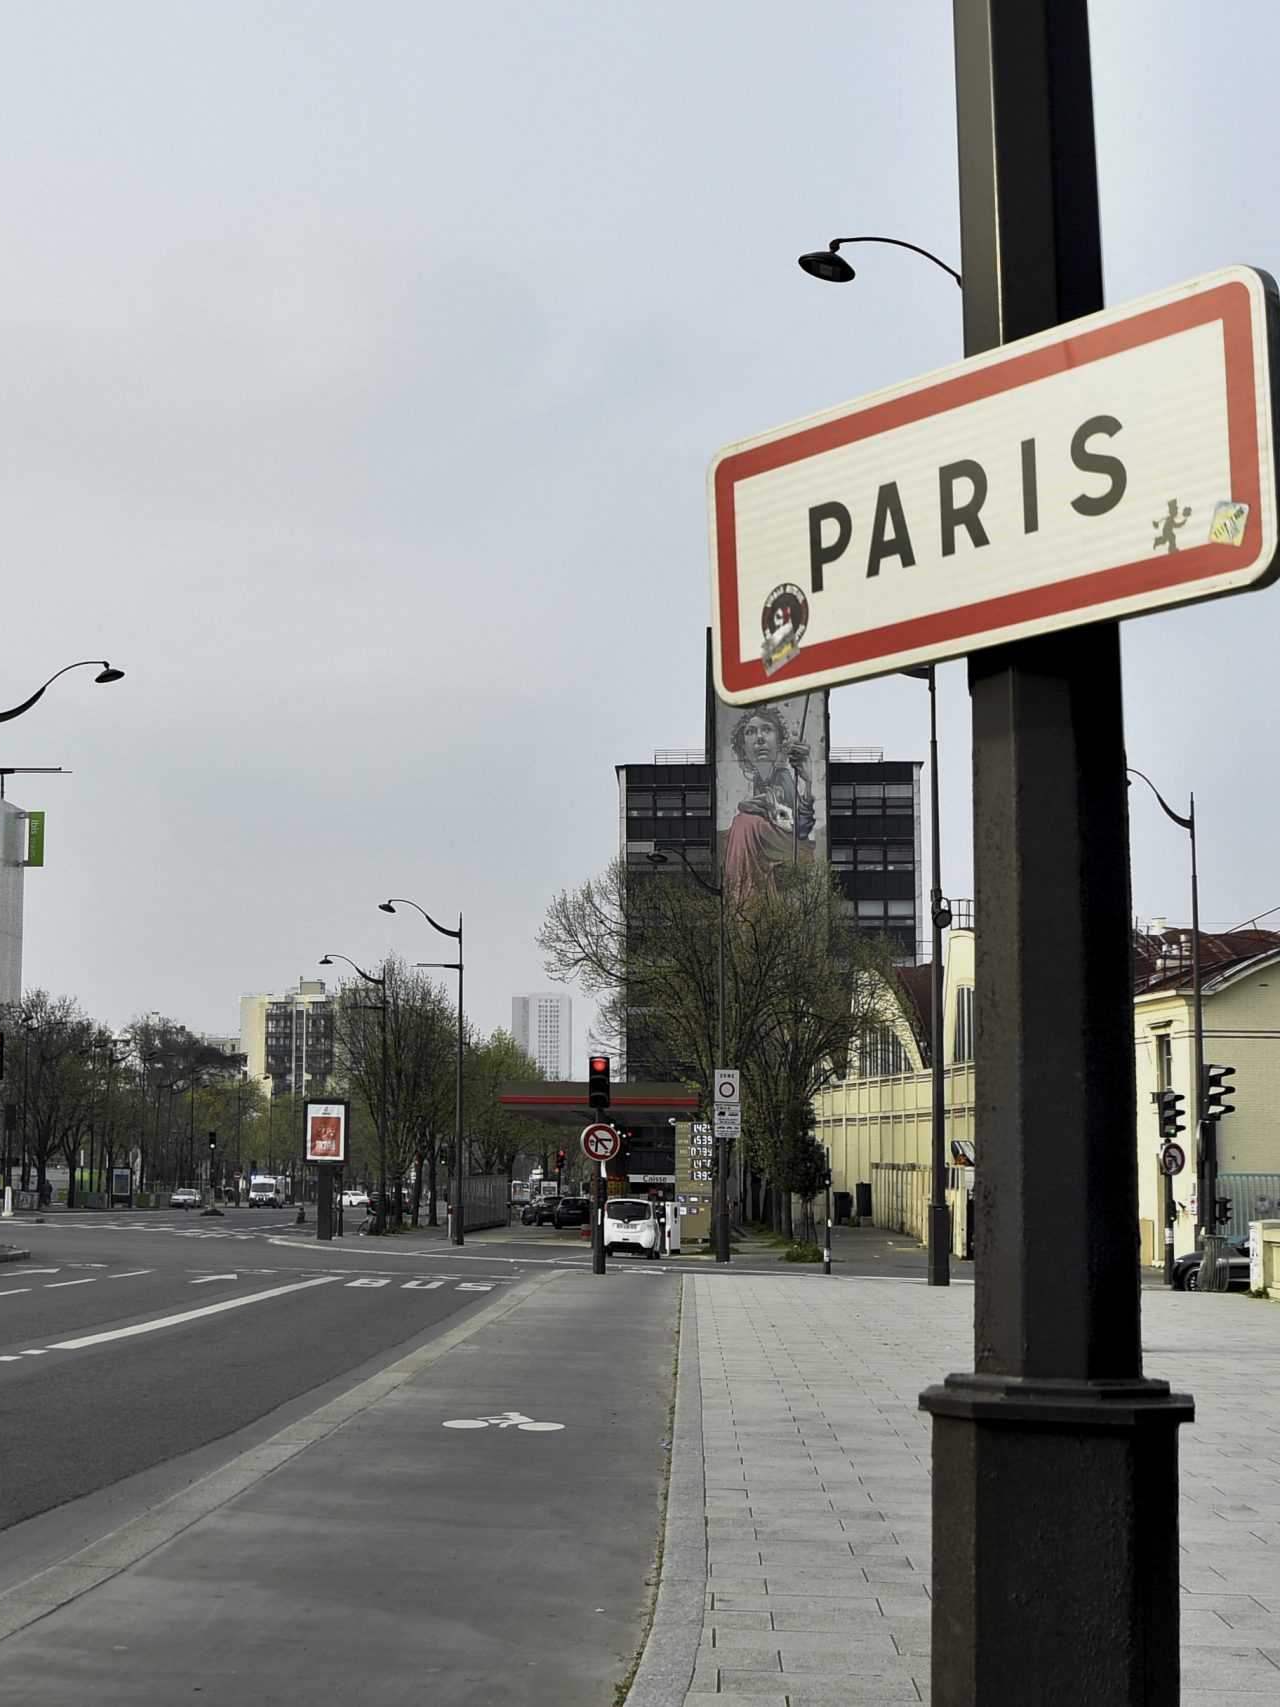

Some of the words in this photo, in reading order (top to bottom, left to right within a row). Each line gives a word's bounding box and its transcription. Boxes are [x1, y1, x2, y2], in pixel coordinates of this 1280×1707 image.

[808, 414, 1128, 594] PARIS
[642, 1173, 668, 1183] Caisse
[343, 1278, 497, 1291] BUS
